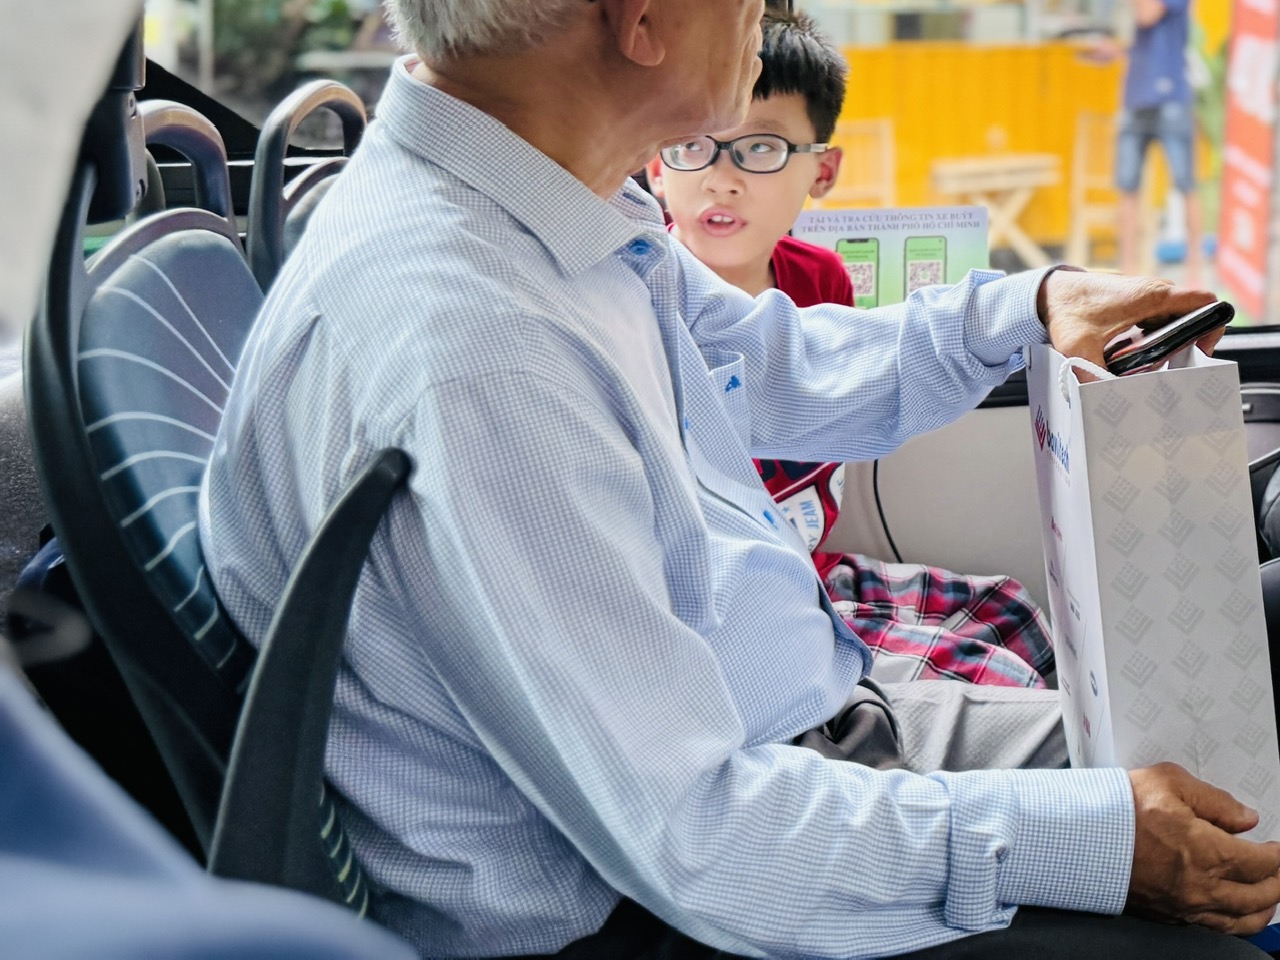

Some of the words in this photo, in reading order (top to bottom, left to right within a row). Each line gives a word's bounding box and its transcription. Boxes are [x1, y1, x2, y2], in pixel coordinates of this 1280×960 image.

[841, 215, 860, 223] TRA
[885, 212, 917, 221] THÔNG
[920, 213, 934, 221] TIN
[802, 223, 826, 233] TRÊN
[868, 221, 899, 231] THÀNH
